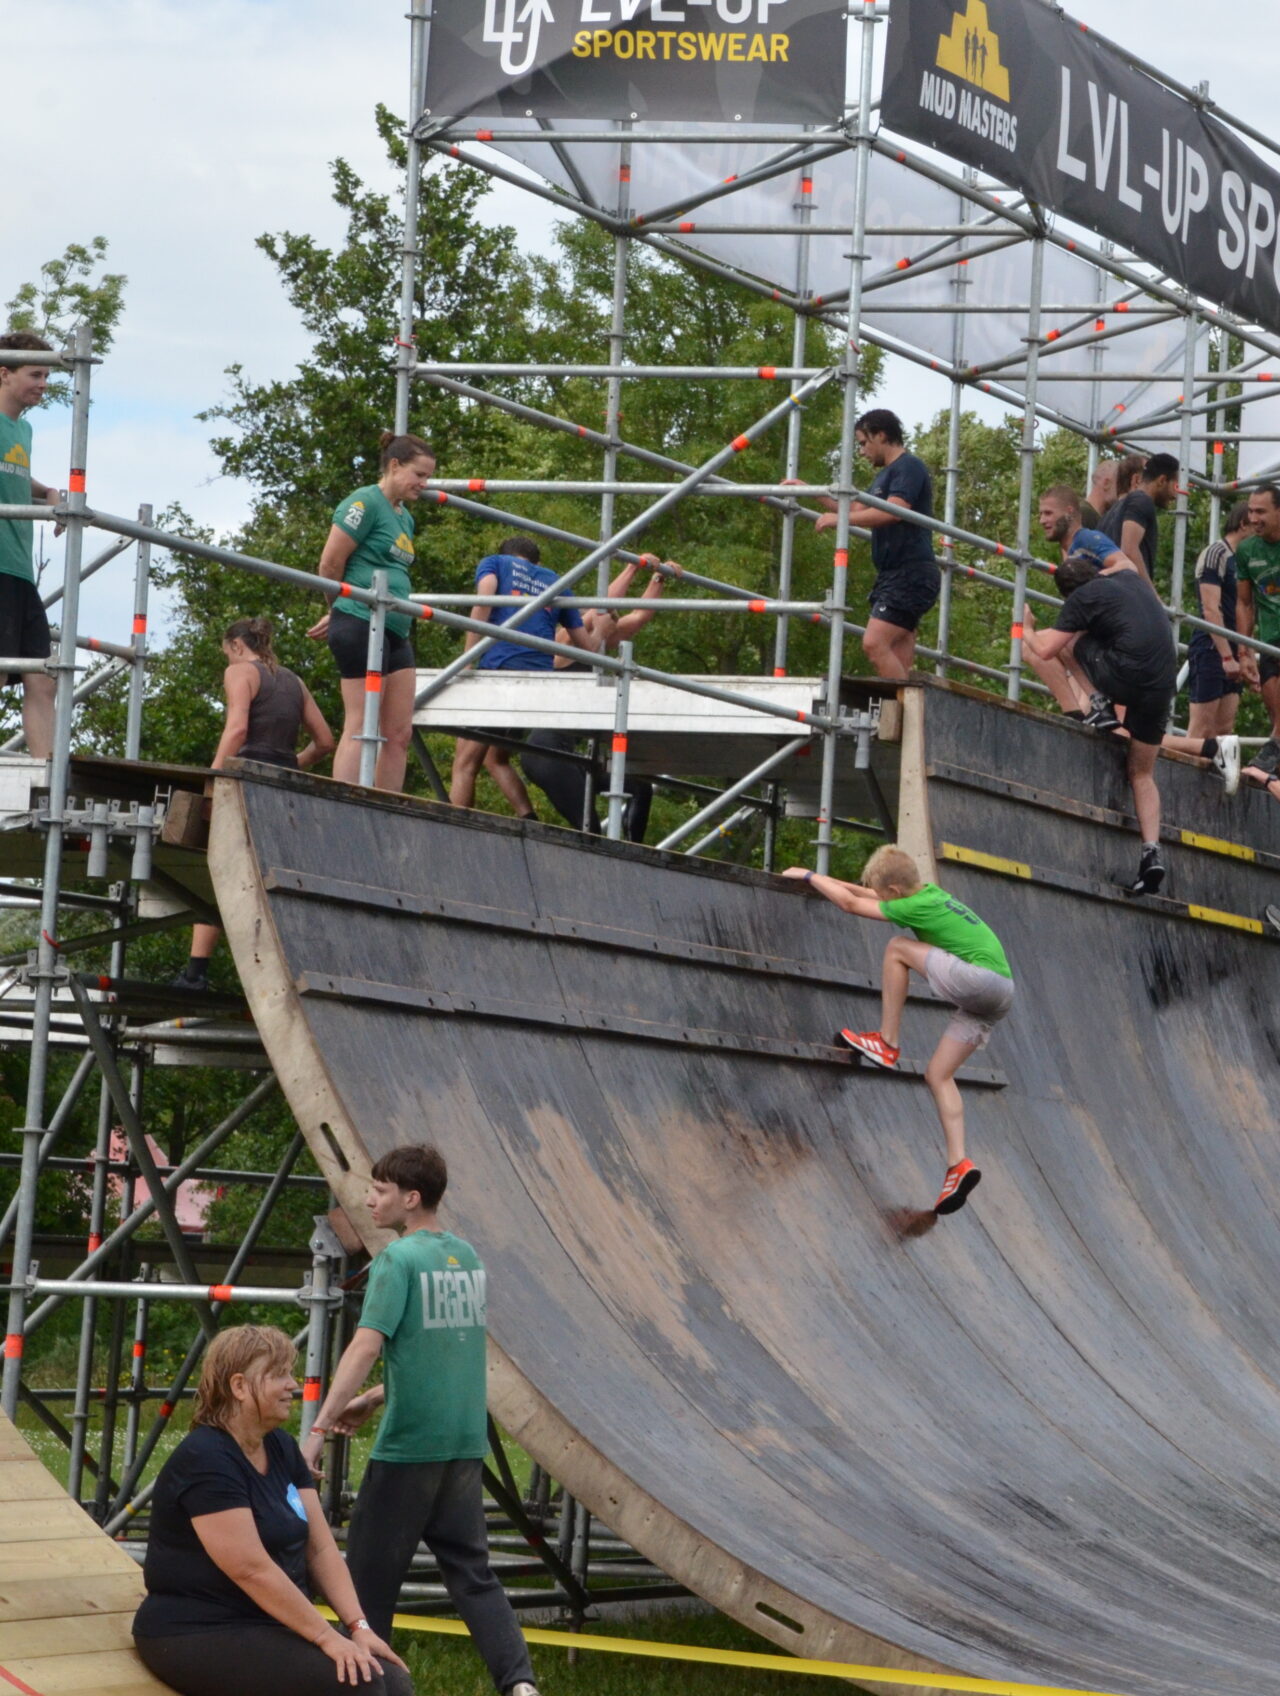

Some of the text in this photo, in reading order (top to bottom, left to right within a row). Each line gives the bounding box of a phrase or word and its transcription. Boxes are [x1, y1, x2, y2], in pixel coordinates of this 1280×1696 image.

[571, 30, 791, 62] SPORTSWEAR
[919, 70, 1018, 153] MUD MASTERS
[1056, 65, 1209, 244] LVL-UP
[343, 508, 363, 526] 25
